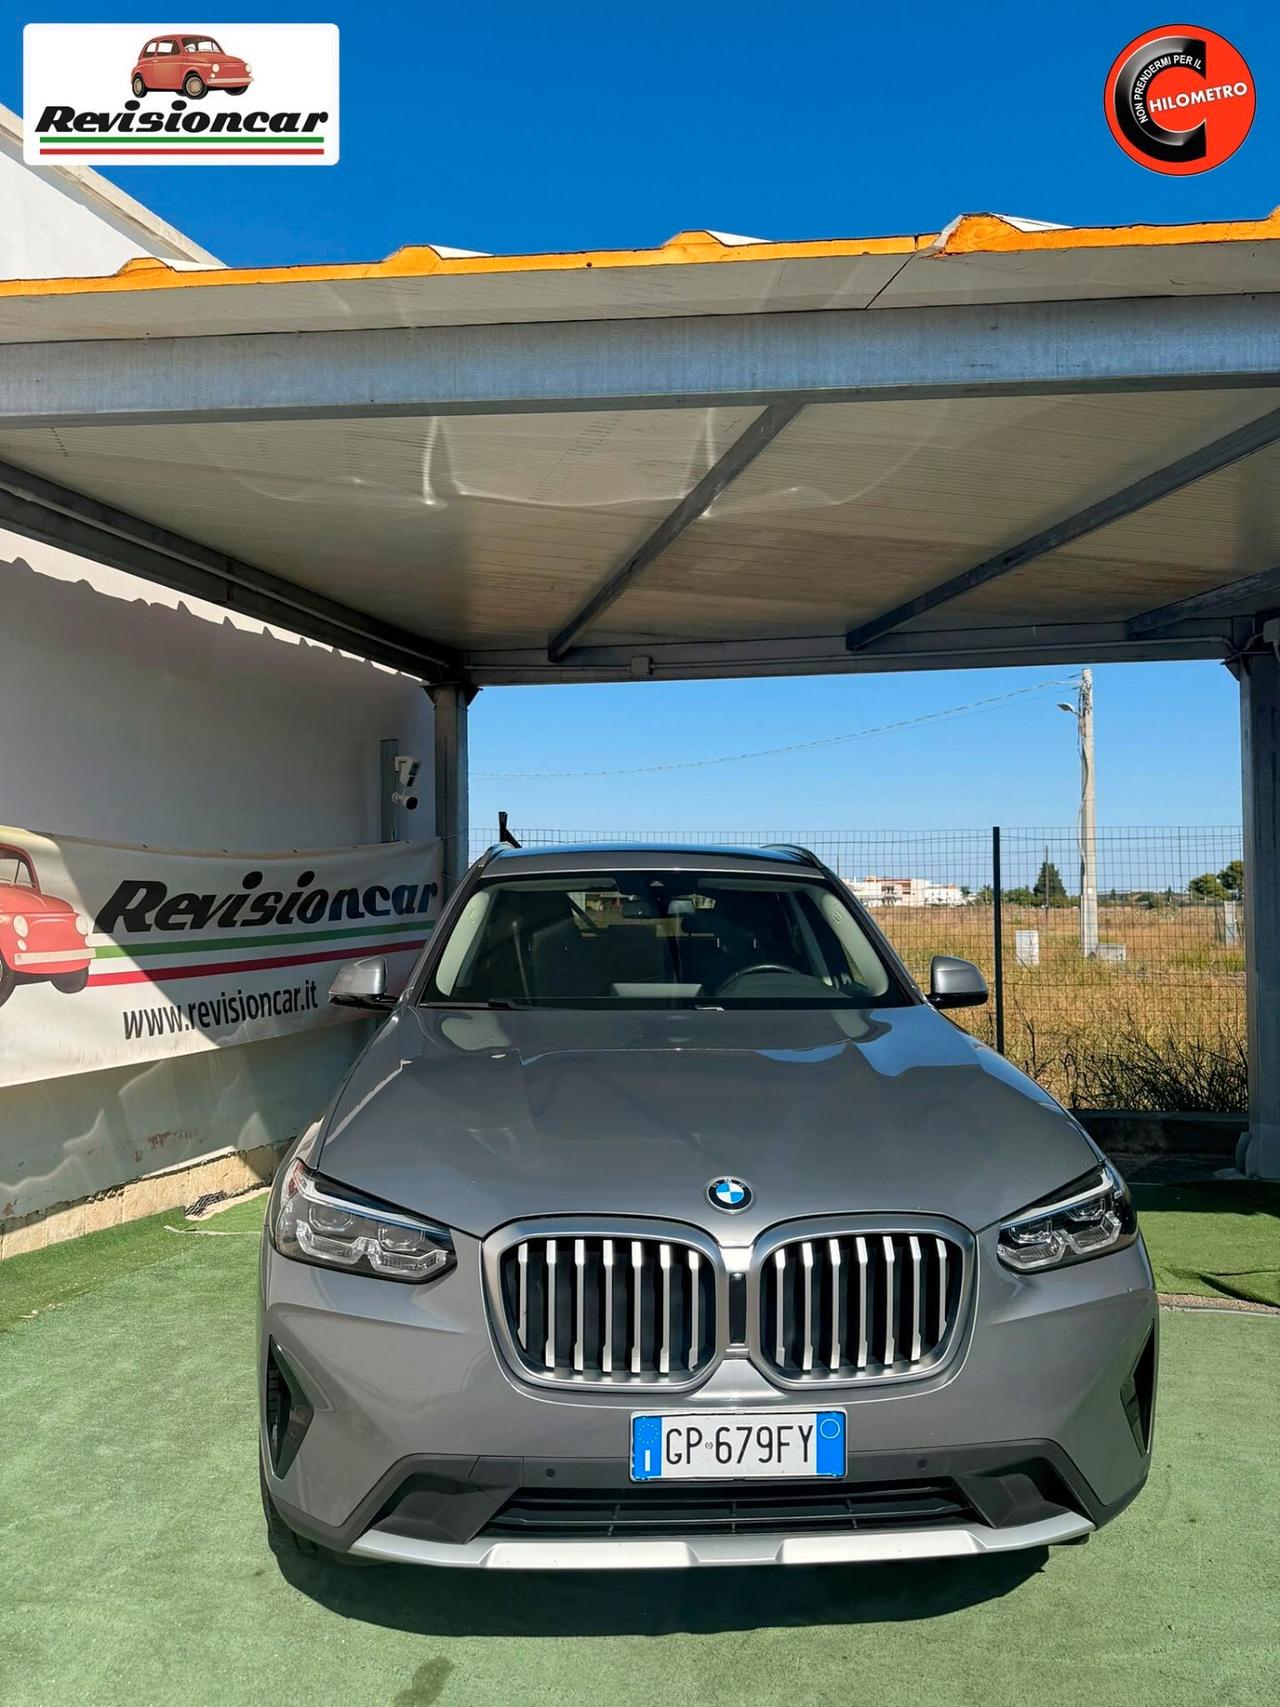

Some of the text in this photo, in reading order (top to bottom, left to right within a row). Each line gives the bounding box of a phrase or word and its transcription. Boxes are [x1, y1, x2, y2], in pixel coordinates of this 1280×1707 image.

[92, 871, 438, 934] Revisioncar
[122, 980, 319, 1040] www.revisioncar.it
[666, 1425, 813, 1465] GP 679FY
